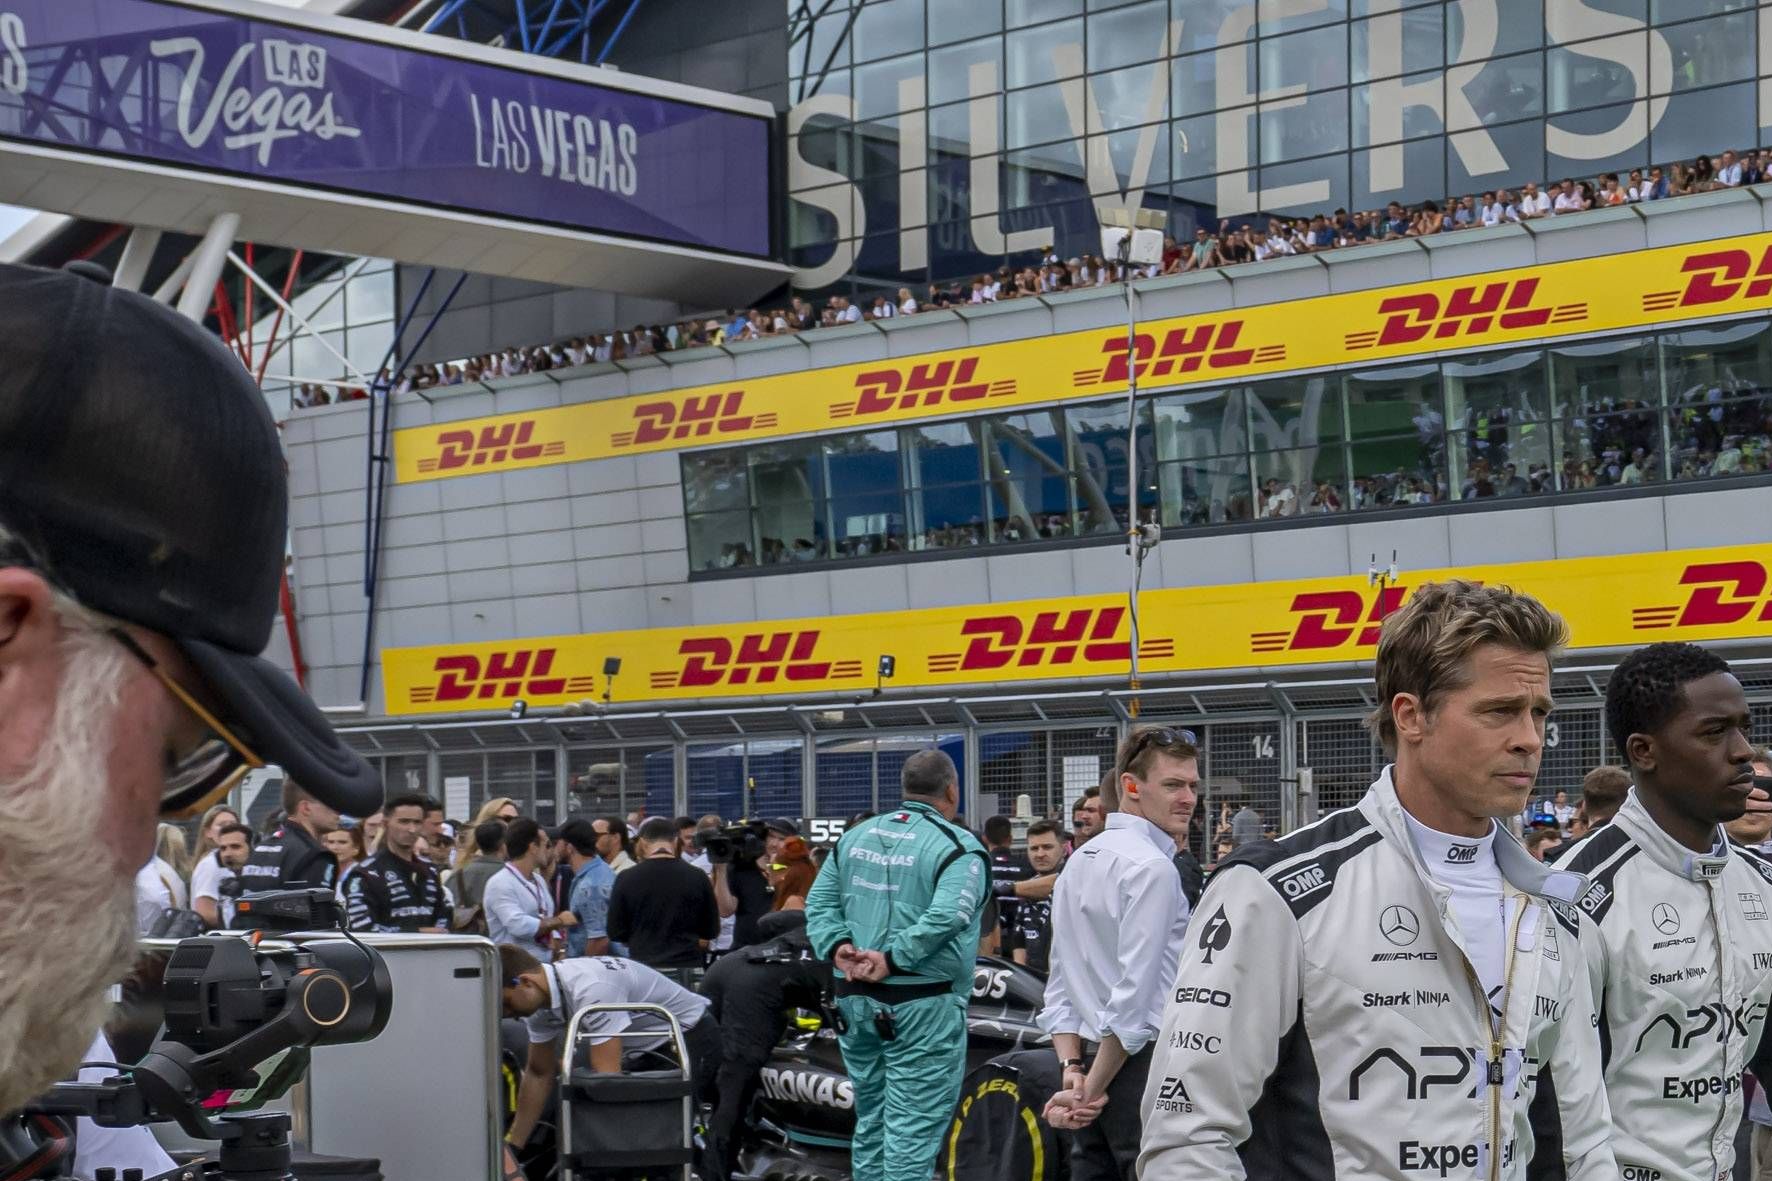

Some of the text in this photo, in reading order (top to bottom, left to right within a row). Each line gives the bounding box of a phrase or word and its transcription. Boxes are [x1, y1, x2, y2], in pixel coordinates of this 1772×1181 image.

[269, 44, 321, 82] LAS
[150, 36, 360, 167] Vegas
[470, 93, 637, 195] LAS VEGAS
[1378, 277, 1553, 346] DHL
[1102, 321, 1256, 382] DHL
[855, 357, 990, 414] DHL
[634, 391, 755, 444] DHL
[438, 420, 546, 470] DHL
[960, 606, 1133, 671] DHL
[679, 631, 832, 687] DHL
[435, 648, 567, 701] DHL
[1252, 734, 1274, 760] 14
[1539, 721, 1560, 748] 3
[810, 819, 846, 843] 55
[1447, 845, 1479, 860] OMP
[1283, 868, 1326, 897] OMP
[1581, 883, 1608, 911] OMP
[1207, 918, 1224, 944] 7
[1396, 952, 1438, 961] AMG
[1650, 968, 1684, 986] Shark
[1175, 987, 1231, 1007] GEICO
[1363, 990, 1450, 1008] Shark NINJA
[1535, 995, 1560, 1022] IWC
[1175, 1032, 1222, 1054] MSC
[1159, 1077, 1191, 1101] EA
[1156, 1100, 1193, 1113] SPORTS
